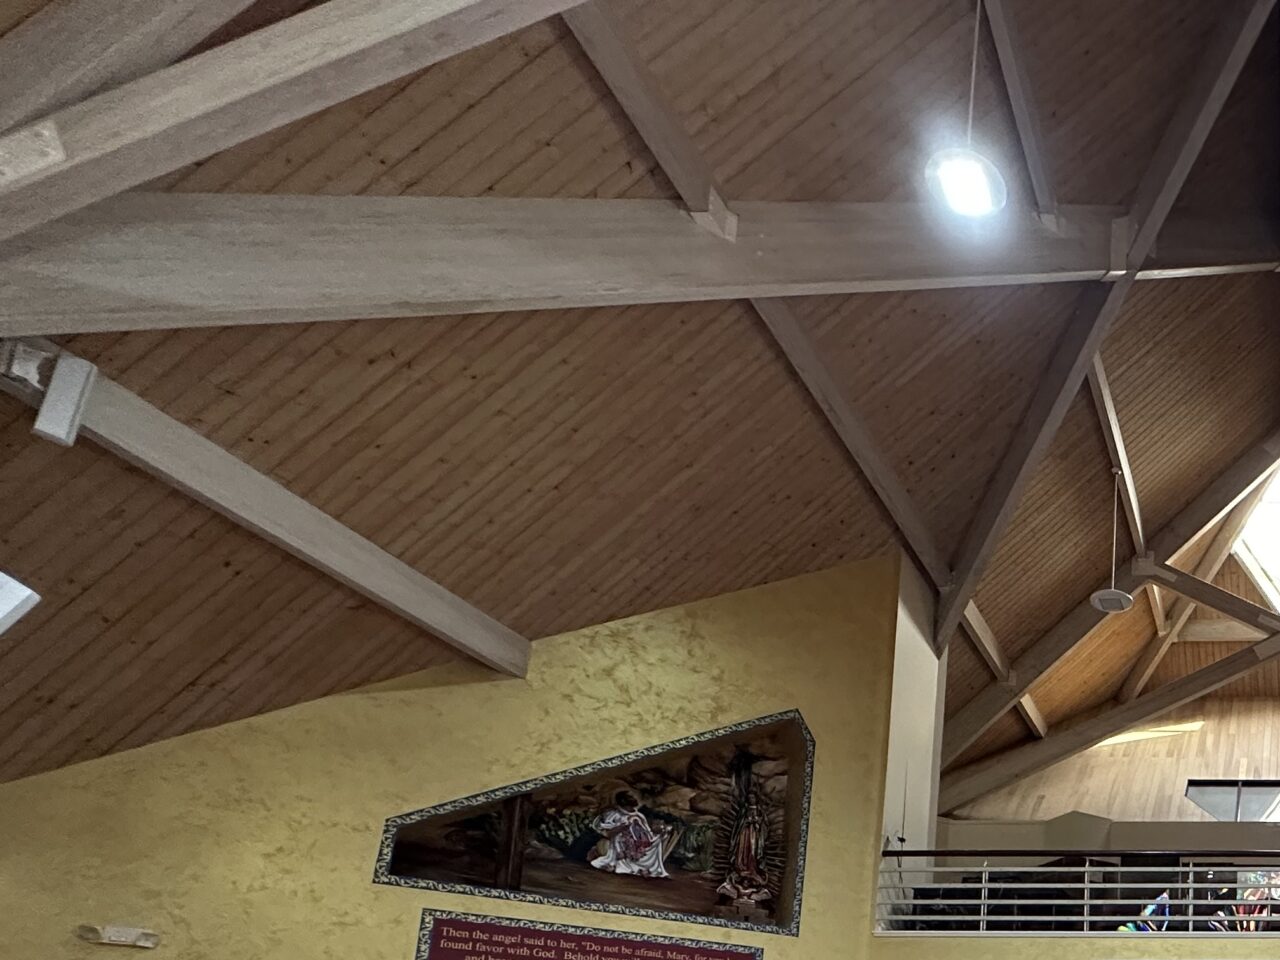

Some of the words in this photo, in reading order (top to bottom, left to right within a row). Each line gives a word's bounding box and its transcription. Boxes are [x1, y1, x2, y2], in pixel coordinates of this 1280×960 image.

[440, 926, 469, 938] Then
[472, 930, 490, 940] the
[492, 934, 521, 944] angel
[524, 937, 544, 946] said
[622, 946, 632, 954] be
[440, 939, 472, 950] found
[476, 942, 504, 953] favor
[507, 946, 530, 956] with
